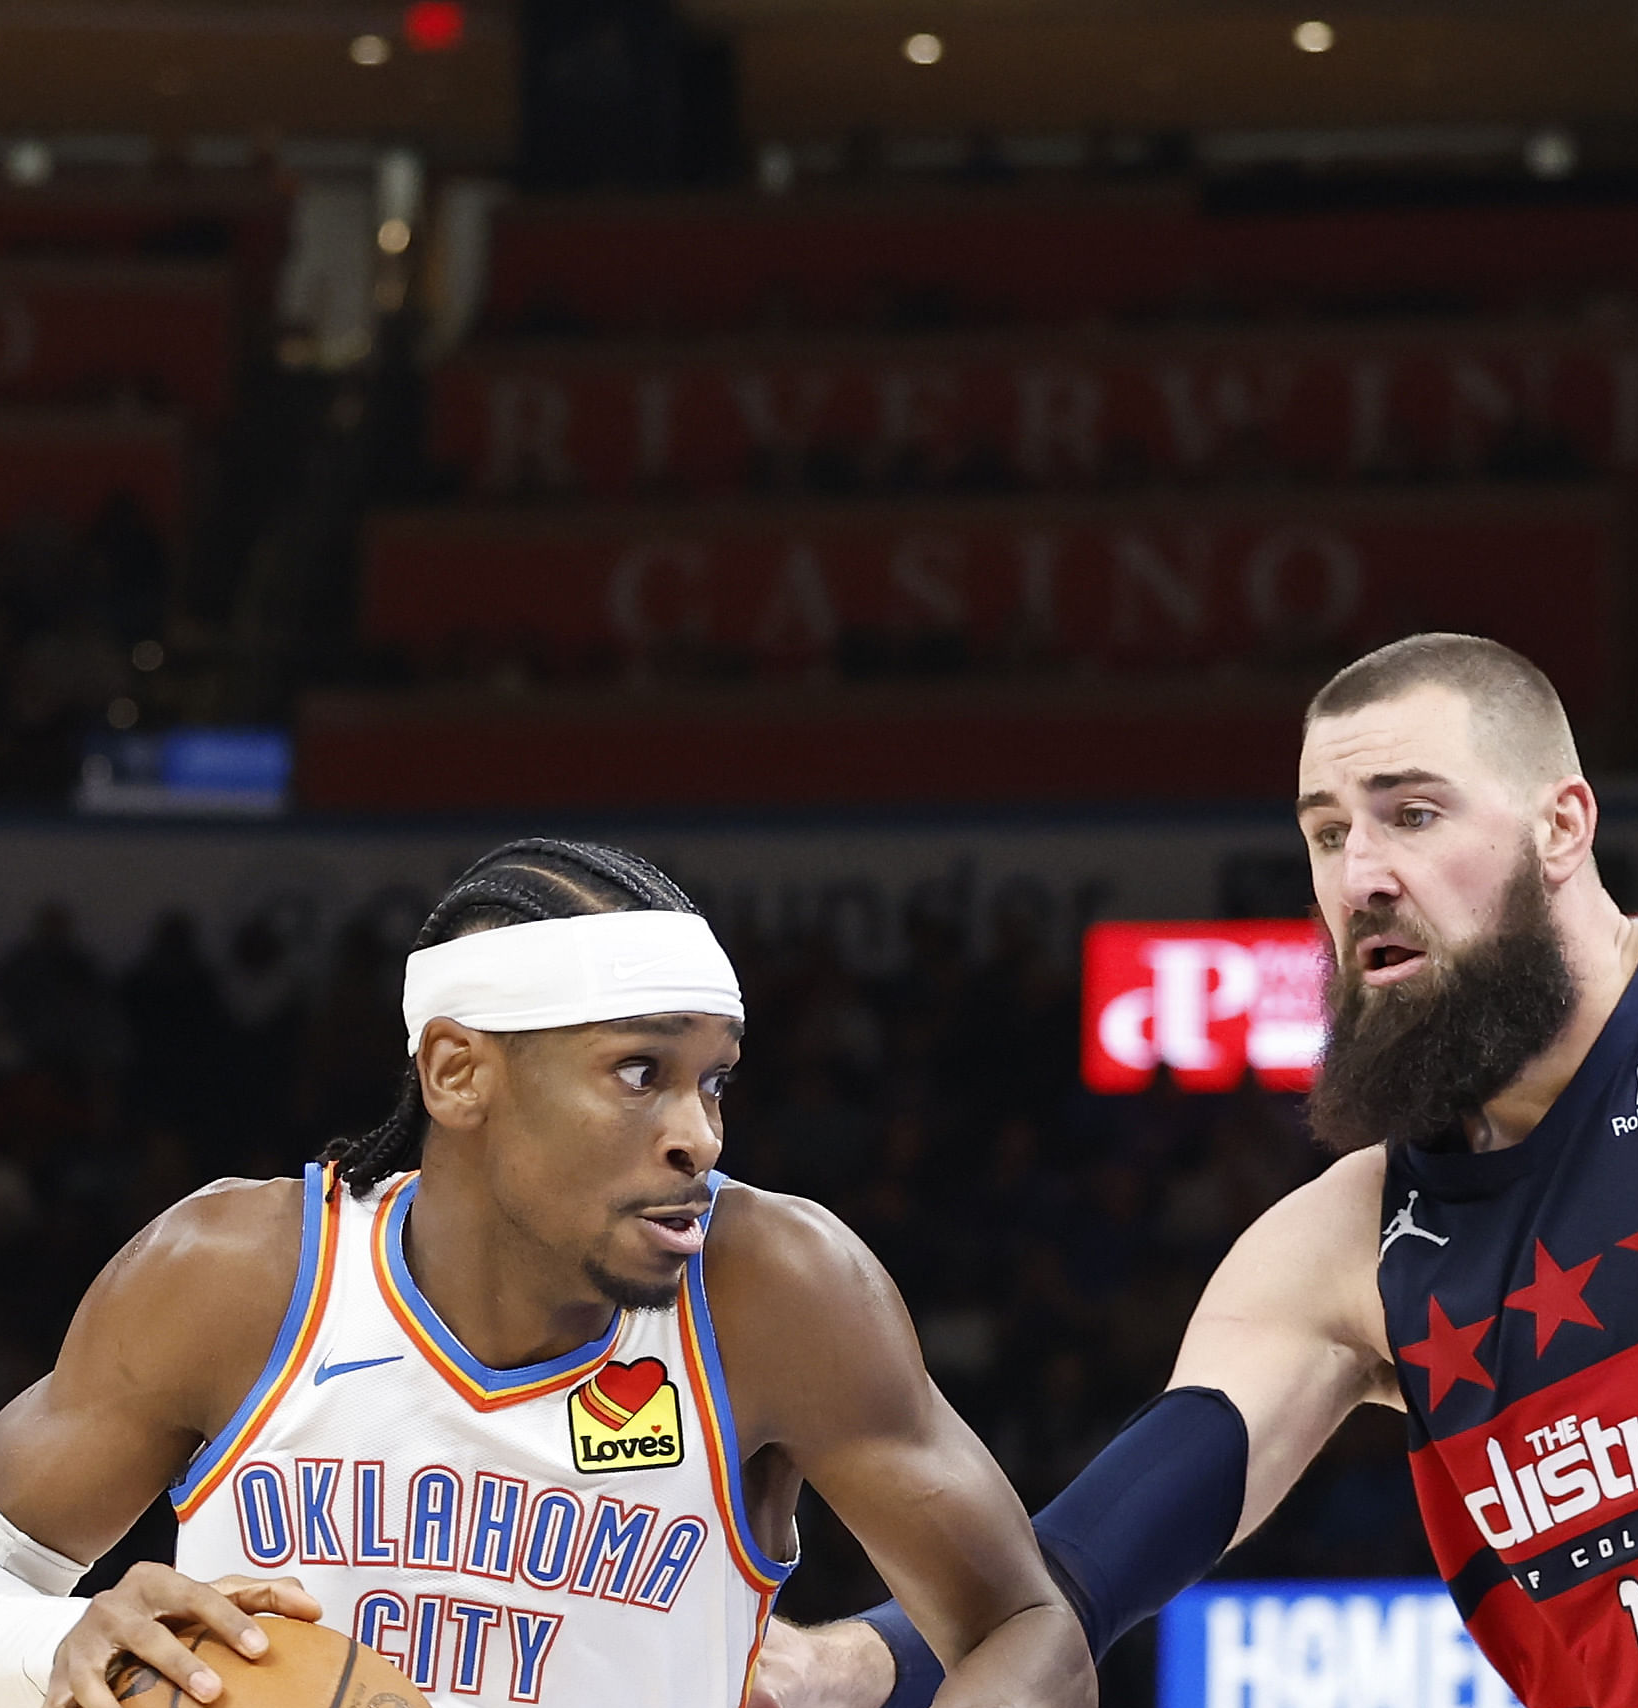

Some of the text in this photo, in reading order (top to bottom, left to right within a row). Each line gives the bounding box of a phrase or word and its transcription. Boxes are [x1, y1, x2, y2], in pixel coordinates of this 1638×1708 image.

[605, 526, 1365, 650] CASINO
[1524, 1414, 1581, 1456] THE
[233, 1458, 709, 1613] OKLAHOMA
[352, 1589, 564, 1704] CITY
